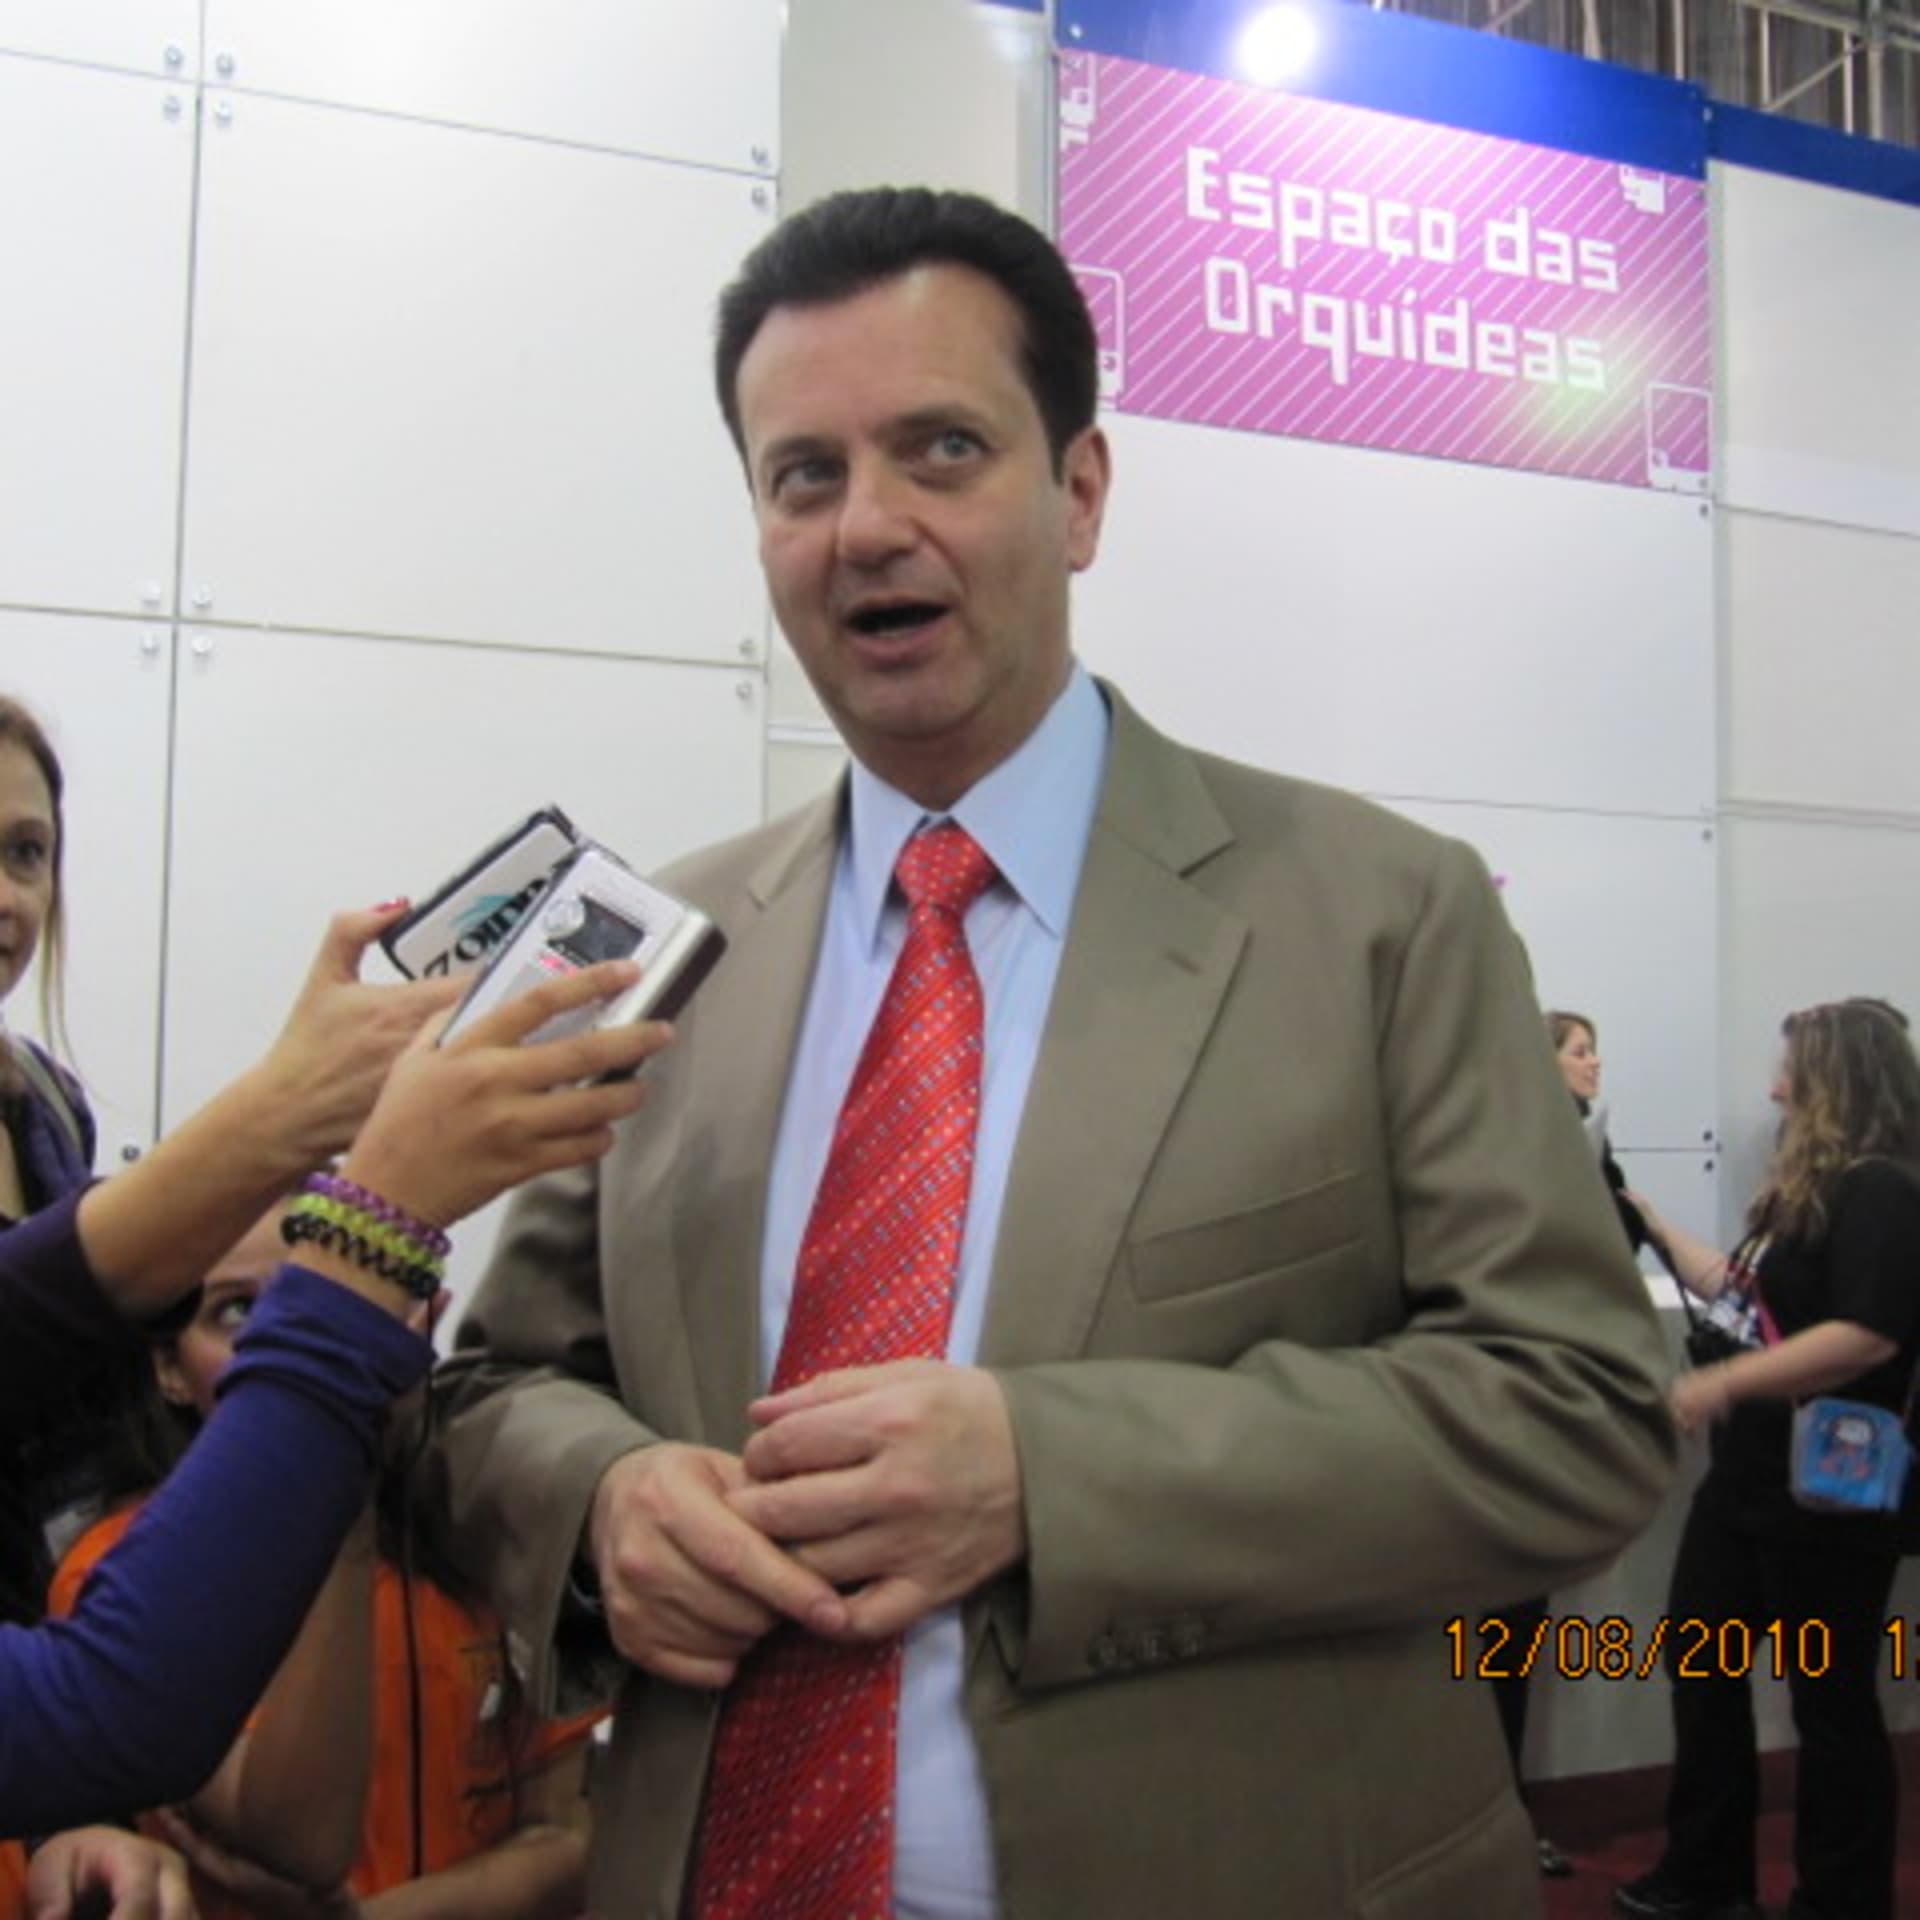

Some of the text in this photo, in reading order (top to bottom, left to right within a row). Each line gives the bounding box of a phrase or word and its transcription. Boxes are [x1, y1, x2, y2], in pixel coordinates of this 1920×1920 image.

[1186, 147, 1619, 293] Espaço das
[1205, 258, 1608, 391] Orquídeas
